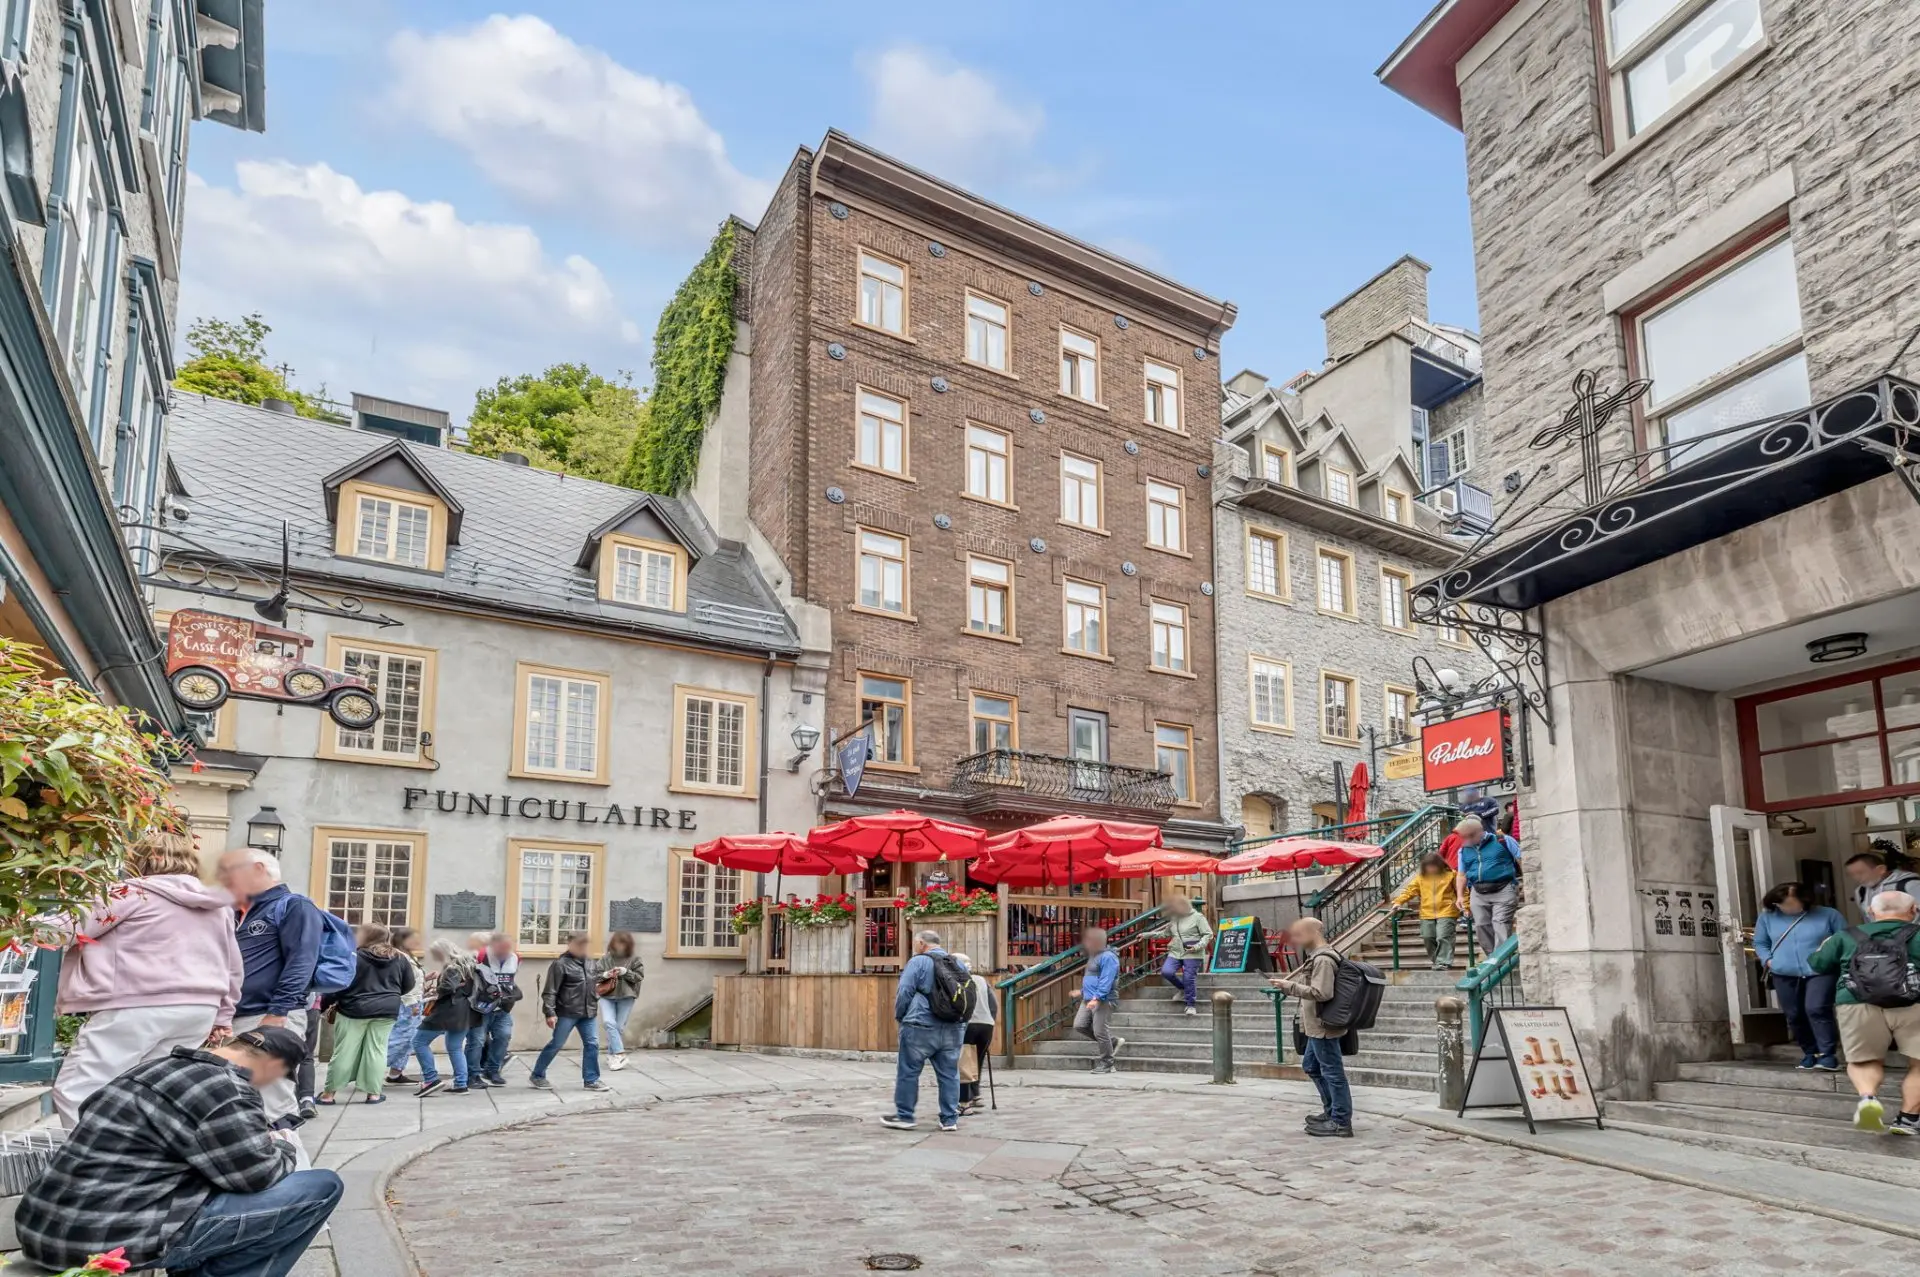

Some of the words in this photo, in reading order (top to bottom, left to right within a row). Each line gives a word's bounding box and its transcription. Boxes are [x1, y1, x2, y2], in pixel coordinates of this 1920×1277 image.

[1427, 737, 1495, 766] Paillard
[403, 787, 698, 830] FUNICULAIRE
[524, 855, 589, 868] SOUVNIRS
